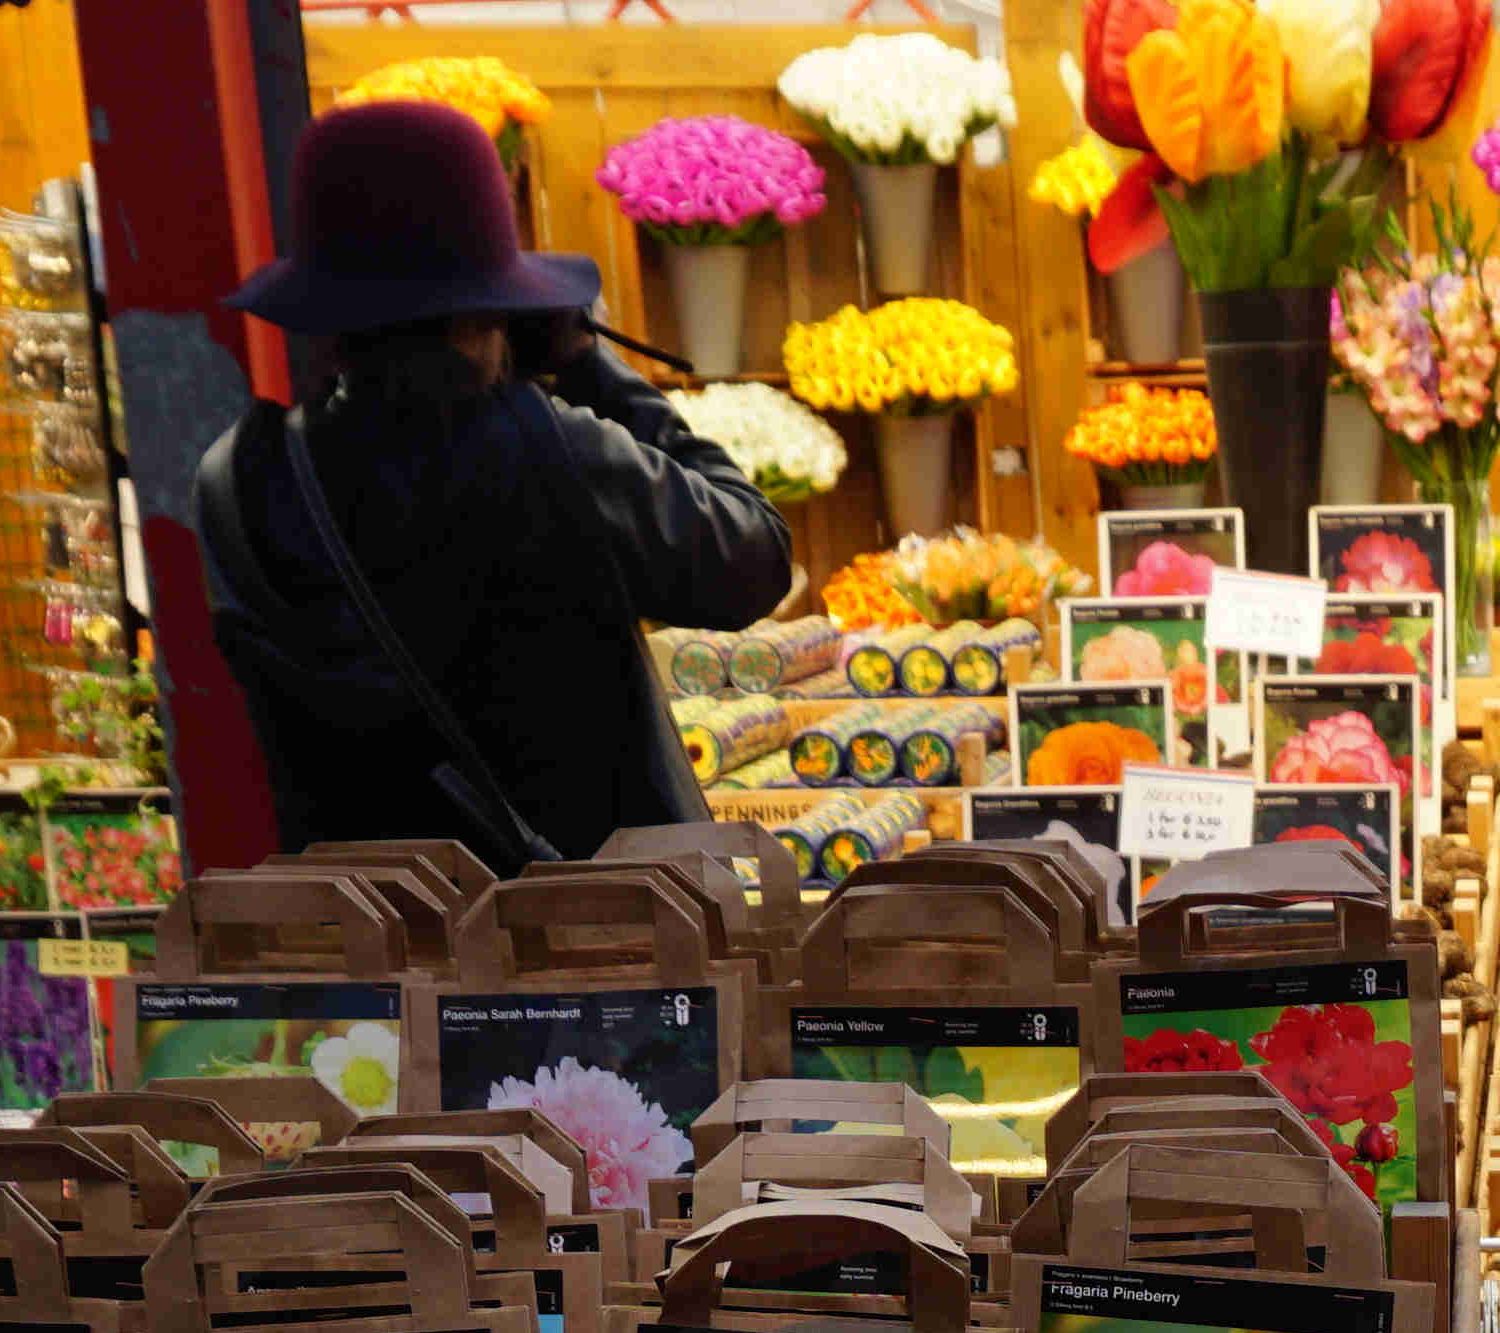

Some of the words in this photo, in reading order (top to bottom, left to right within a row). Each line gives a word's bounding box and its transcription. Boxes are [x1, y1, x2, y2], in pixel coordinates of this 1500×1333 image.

[443, 1009, 488, 1022] Paeonia
[491, 1008, 523, 1021] Sarah
[526, 1007, 581, 1020] Bernhardt
[797, 1020, 843, 1032] Paeonia
[847, 1021, 886, 1033] Yellow
[1051, 1283, 1109, 1299] Fragaria
[1113, 1286, 1181, 1307] Pineberry
